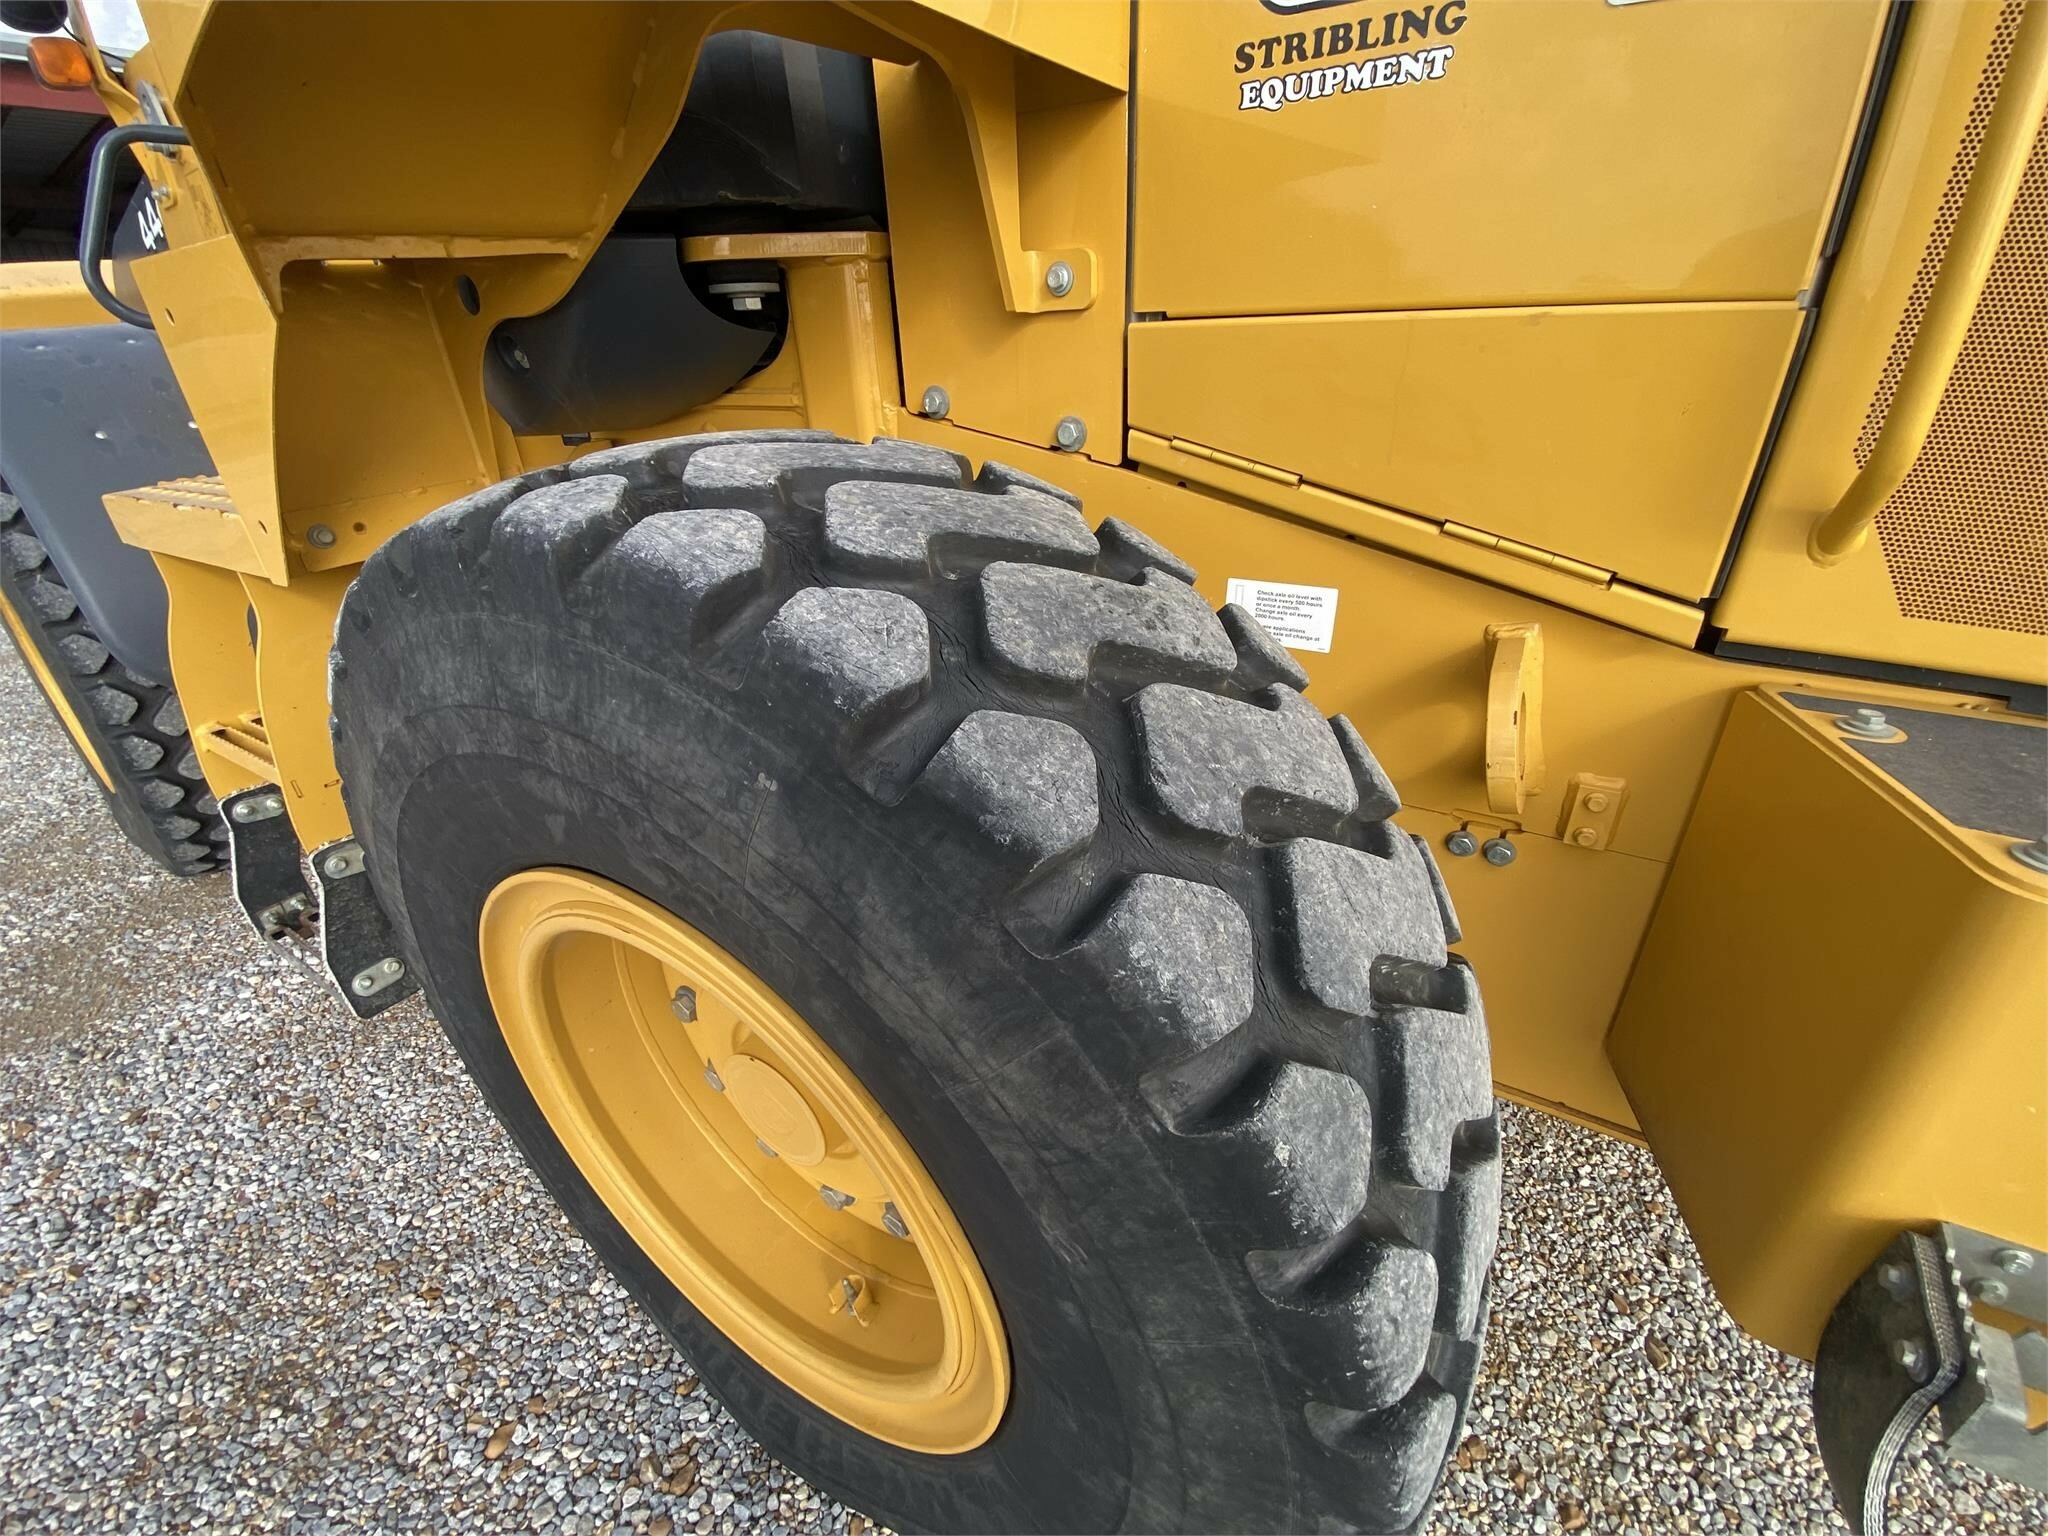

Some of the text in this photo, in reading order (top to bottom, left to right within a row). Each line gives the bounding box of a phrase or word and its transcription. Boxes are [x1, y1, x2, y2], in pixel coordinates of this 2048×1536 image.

[1234, 0, 1468, 73] STRIBLING
[1239, 47, 1454, 111] EQUIPMENT
[137, 196, 164, 250] 44
[1273, 625, 1305, 634] applications
